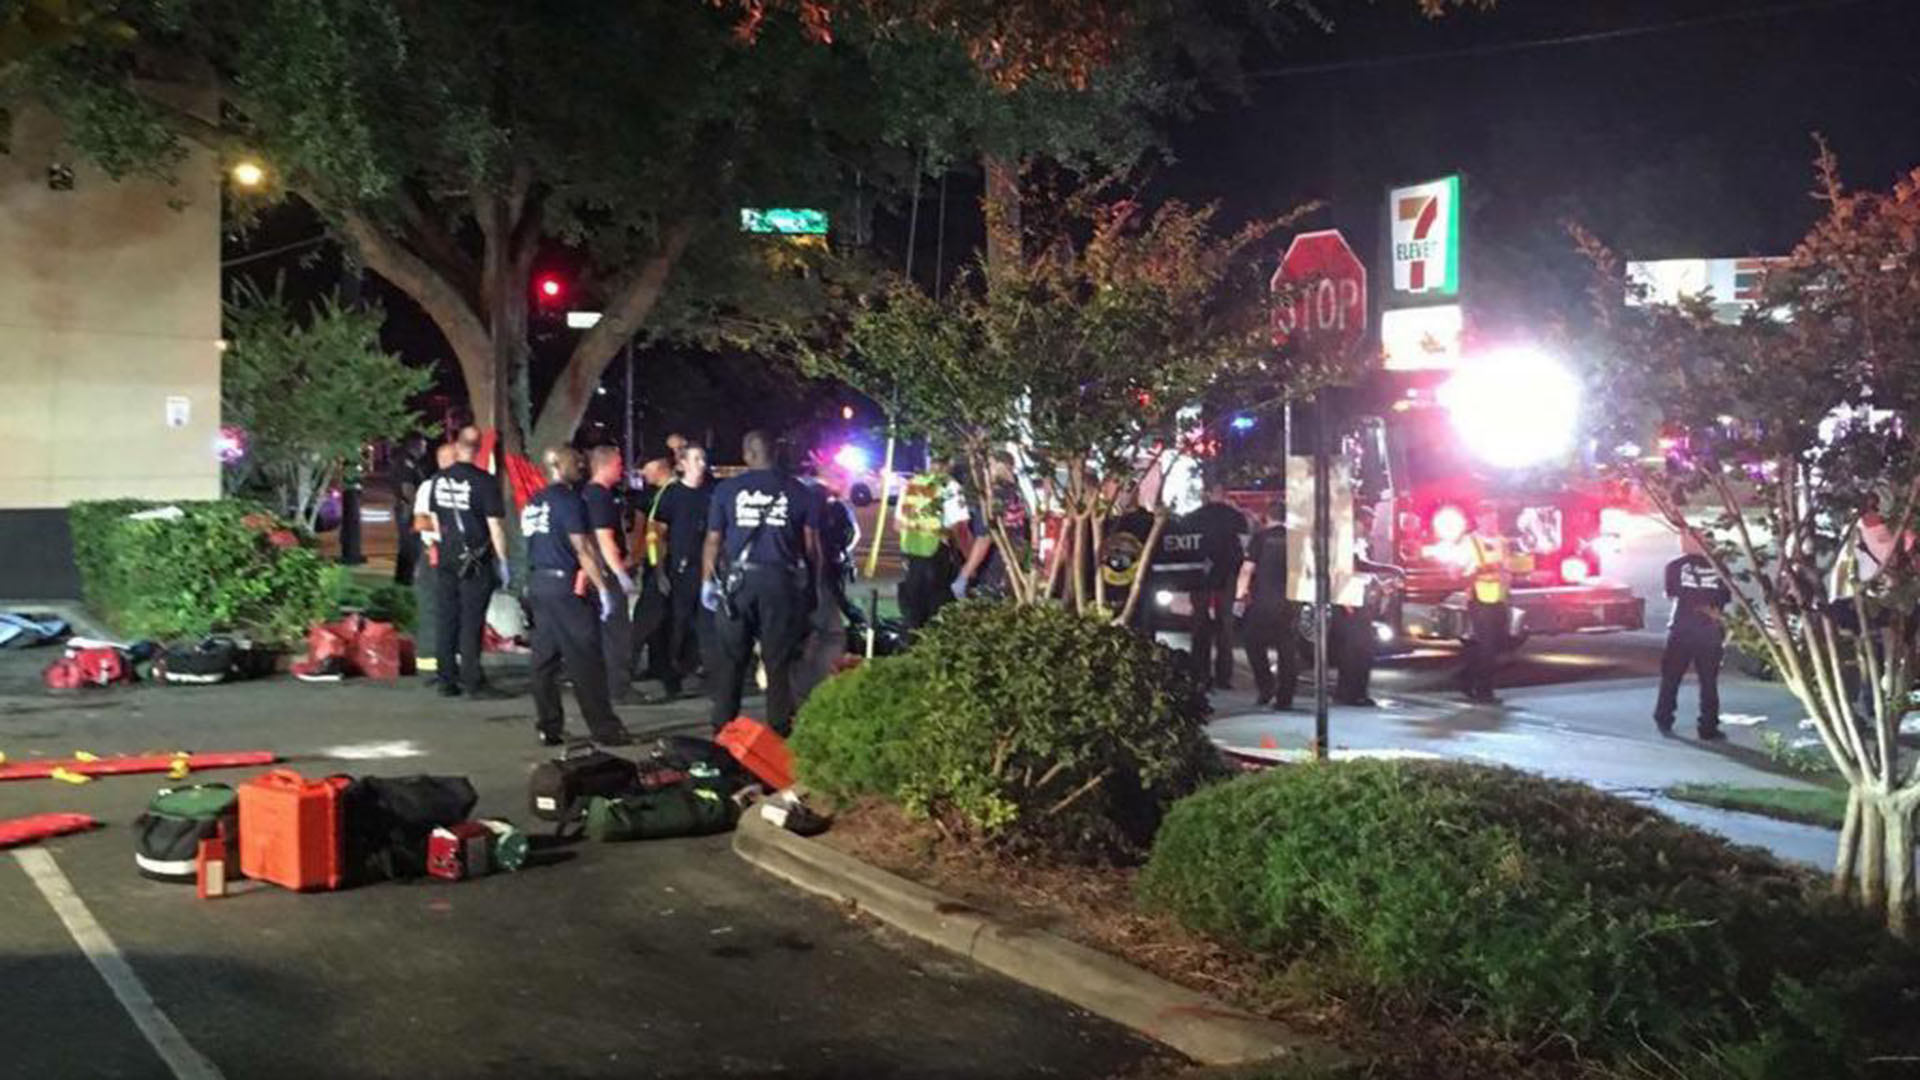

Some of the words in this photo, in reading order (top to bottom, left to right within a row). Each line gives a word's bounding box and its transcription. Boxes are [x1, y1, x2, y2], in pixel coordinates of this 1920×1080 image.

[1396, 241, 1438, 261] ELEVE
[1398, 195, 1438, 290] 7
[1278, 278, 1358, 334] STOP
[1163, 533, 1203, 551] EXIT
